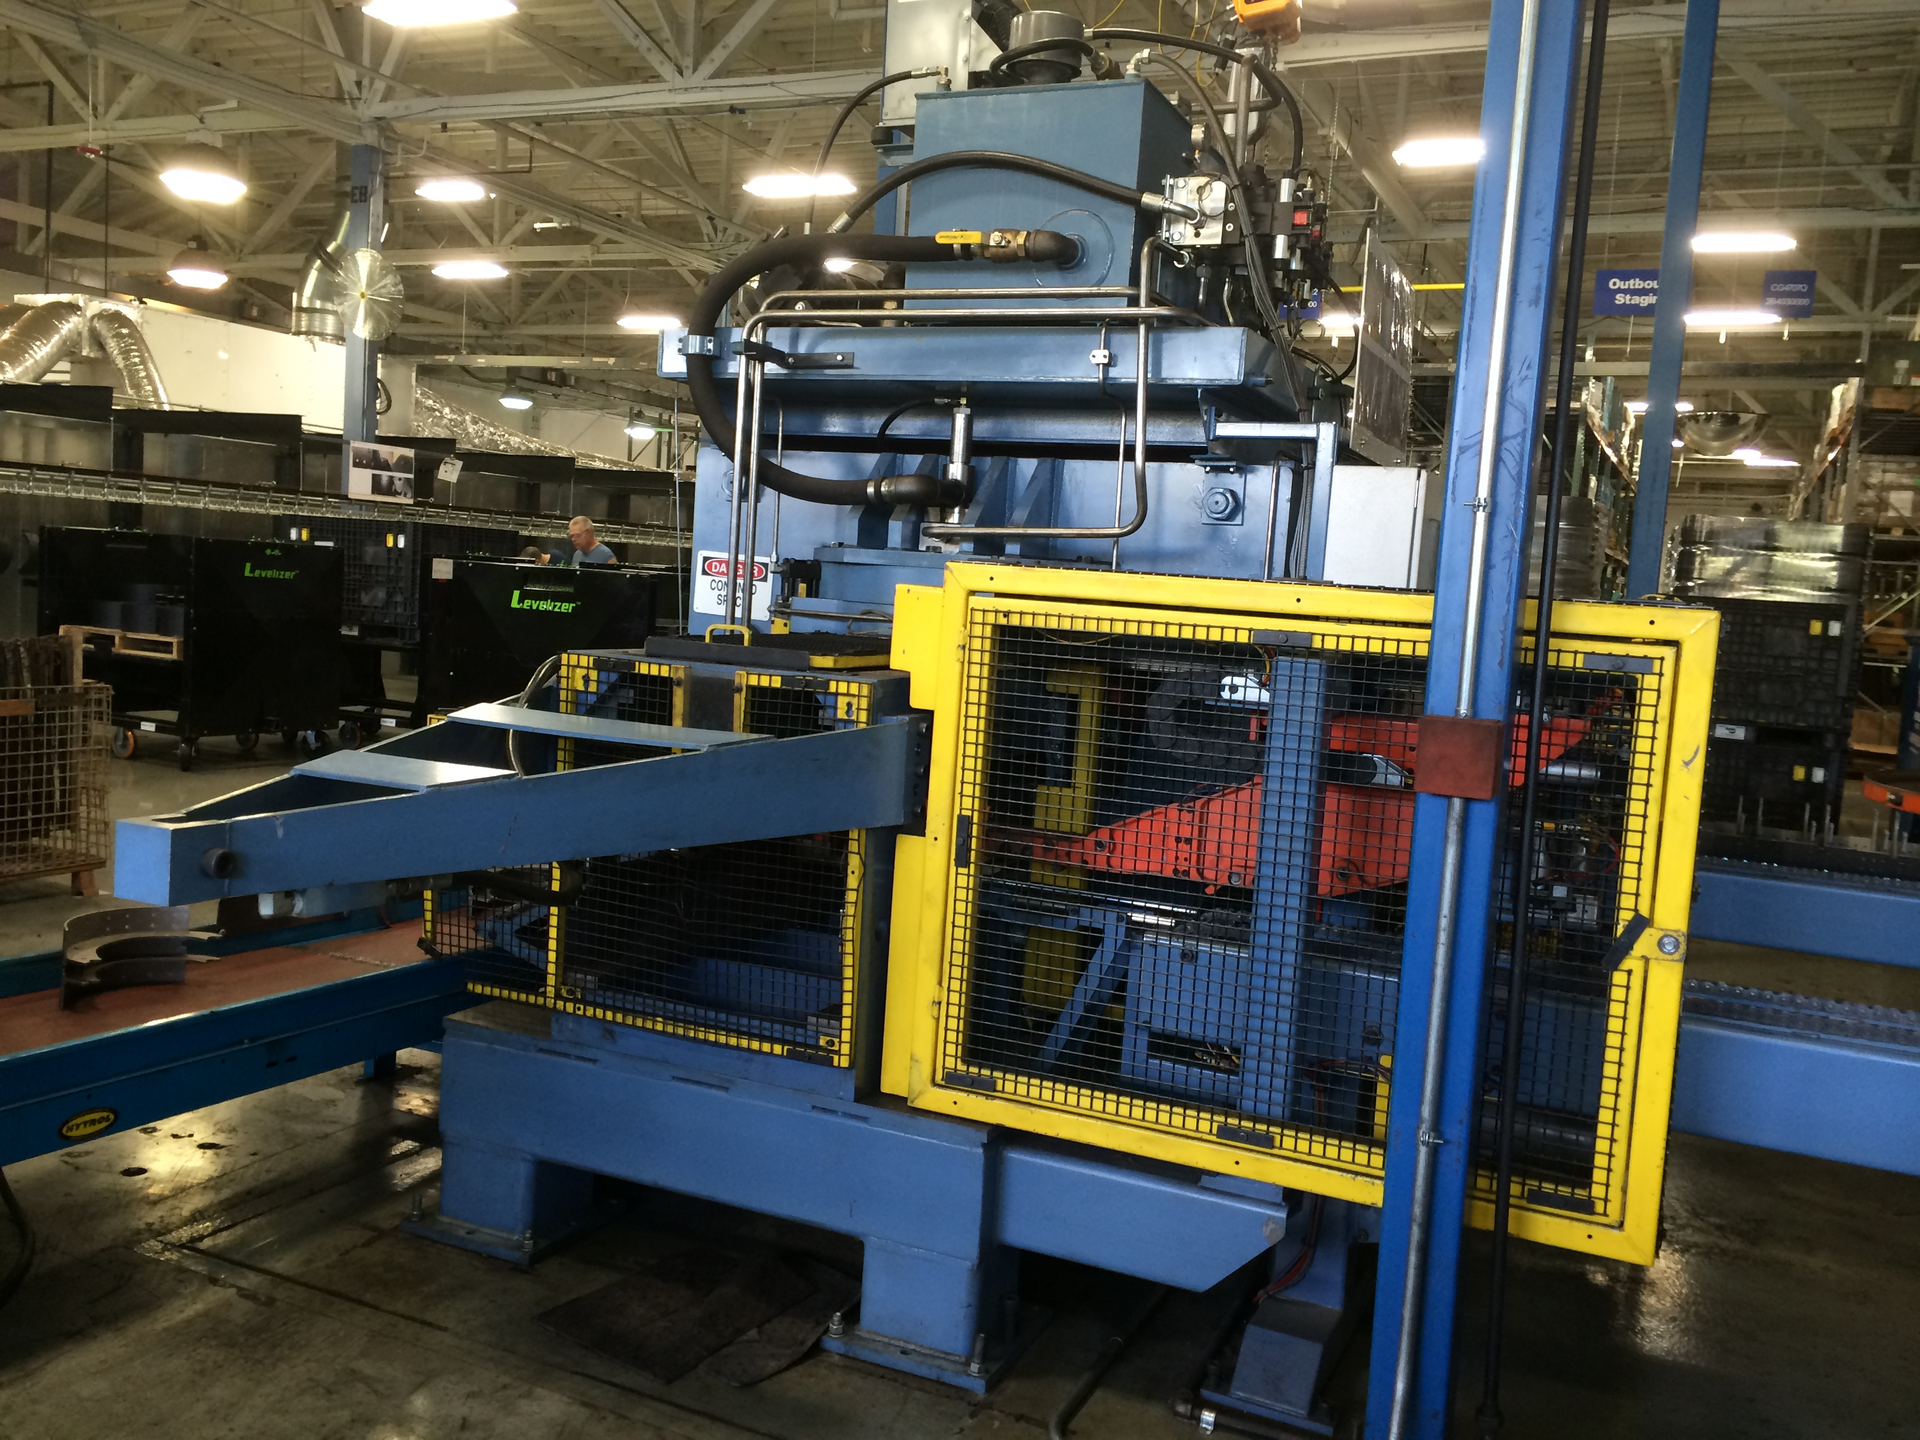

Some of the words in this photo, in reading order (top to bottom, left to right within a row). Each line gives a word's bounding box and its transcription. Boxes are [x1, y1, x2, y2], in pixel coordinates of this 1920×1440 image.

[1609, 278, 1659, 289] Outbou
[1615, 293, 1658, 306] Stagi
[244, 562, 296, 579] Levelizer
[711, 562, 758, 577] DAGR
[710, 579, 757, 595] CONND
[510, 590, 576, 613] Levelizer
[716, 594, 743, 608] SPC
[66, 1114, 112, 1133] HYTROL
